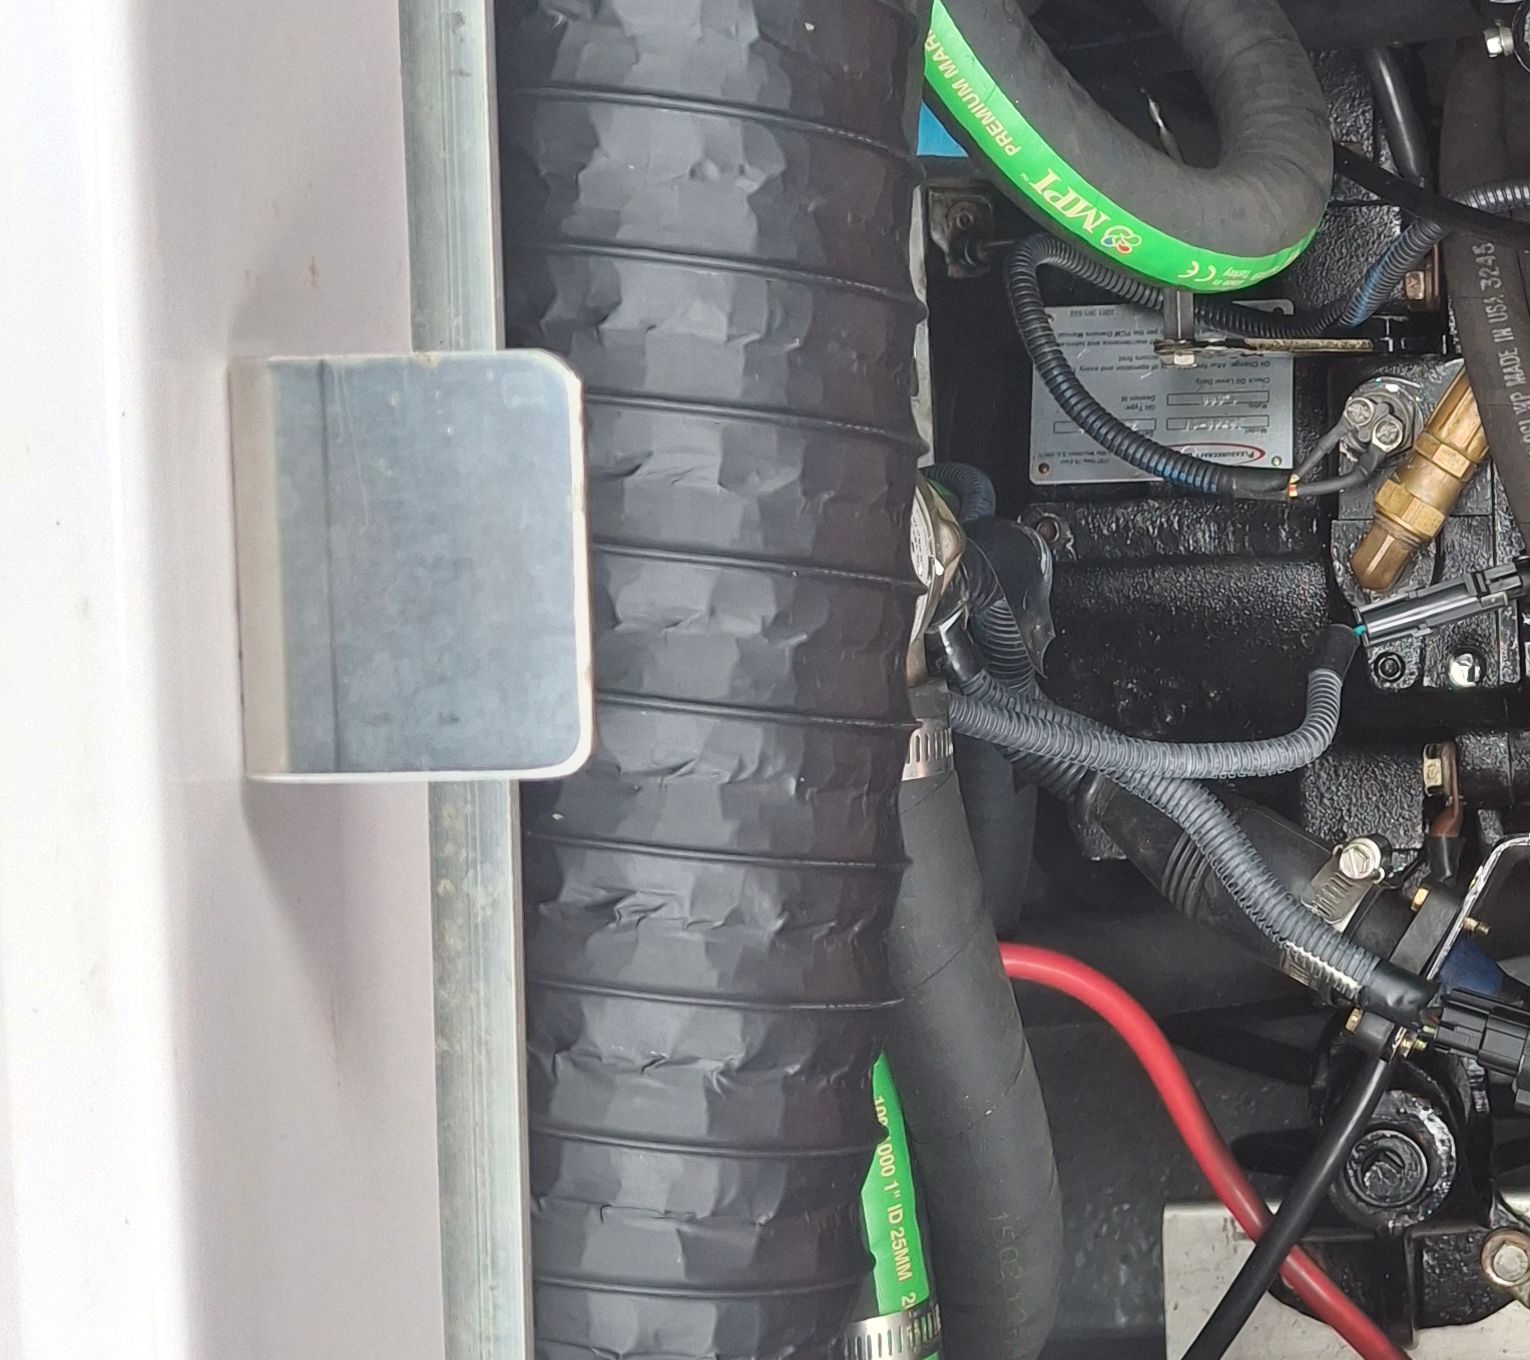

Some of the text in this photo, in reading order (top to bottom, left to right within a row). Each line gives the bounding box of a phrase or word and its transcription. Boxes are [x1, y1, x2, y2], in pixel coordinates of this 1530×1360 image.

[950, 79, 1023, 157] PREMIUM
[1028, 168, 1111, 235] MPI
[1472, 242, 1499, 291] 3245
[1483, 295, 1506, 324] USA
[1492, 328, 1514, 344] IN
[1497, 348, 1527, 388] MADE
[886, 1204, 903, 1225] ID
[891, 1229, 913, 1281] 25MM
